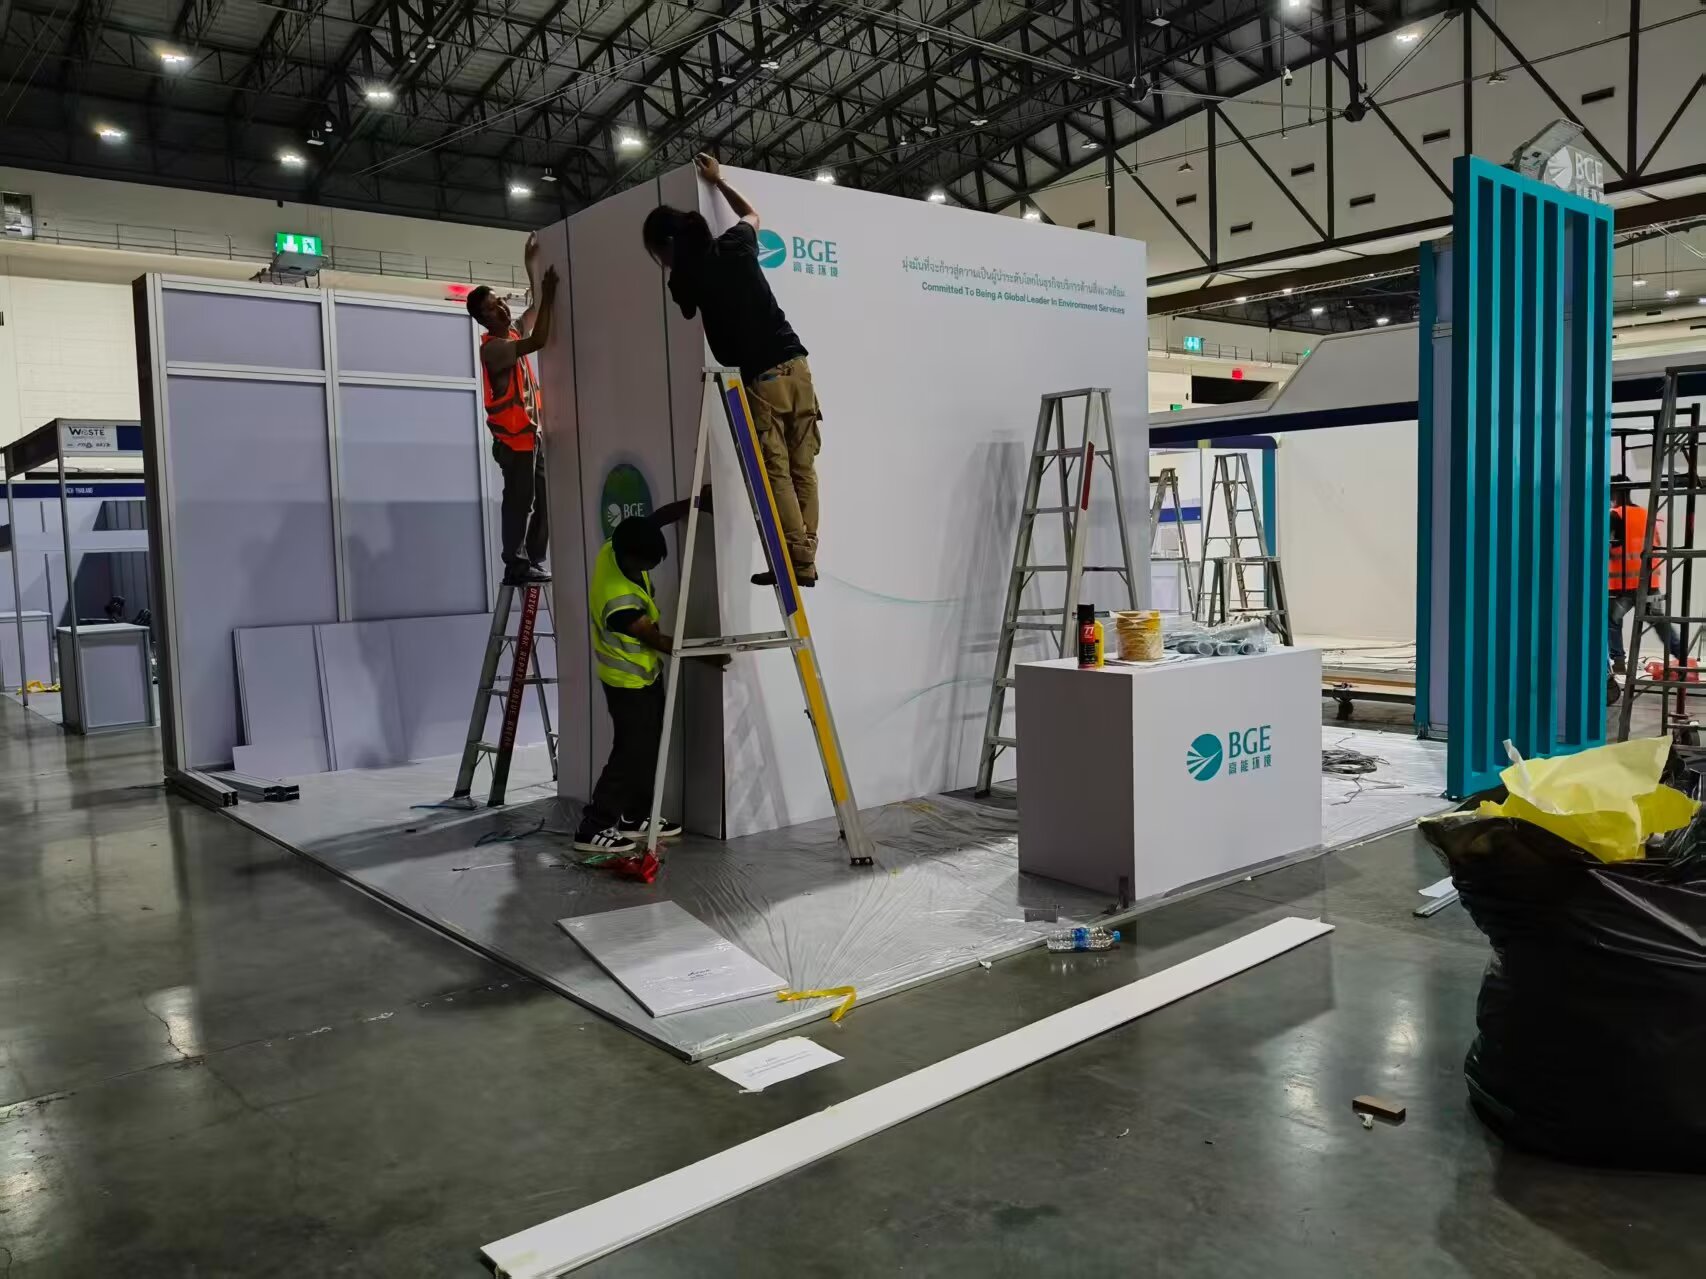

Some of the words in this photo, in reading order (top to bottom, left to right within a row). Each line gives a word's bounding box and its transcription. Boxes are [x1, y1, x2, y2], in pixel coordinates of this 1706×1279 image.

[1575, 152, 1604, 188] BGE
[792, 236, 838, 264] BGE
[922, 281, 963, 295] Committed
[965, 287, 975, 296] To
[975, 288, 996, 300] Being
[997, 291, 1003, 299] A
[1004, 292, 1026, 302] Global
[1027, 294, 1050, 304] Leader
[1058, 298, 1098, 311] Environment
[1098, 303, 1125, 314] Services
[623, 502, 646, 519] BGE
[1083, 626, 1095, 635] 77
[1228, 725, 1272, 758] BGE
[1228, 754, 1272, 776] 高能环境
